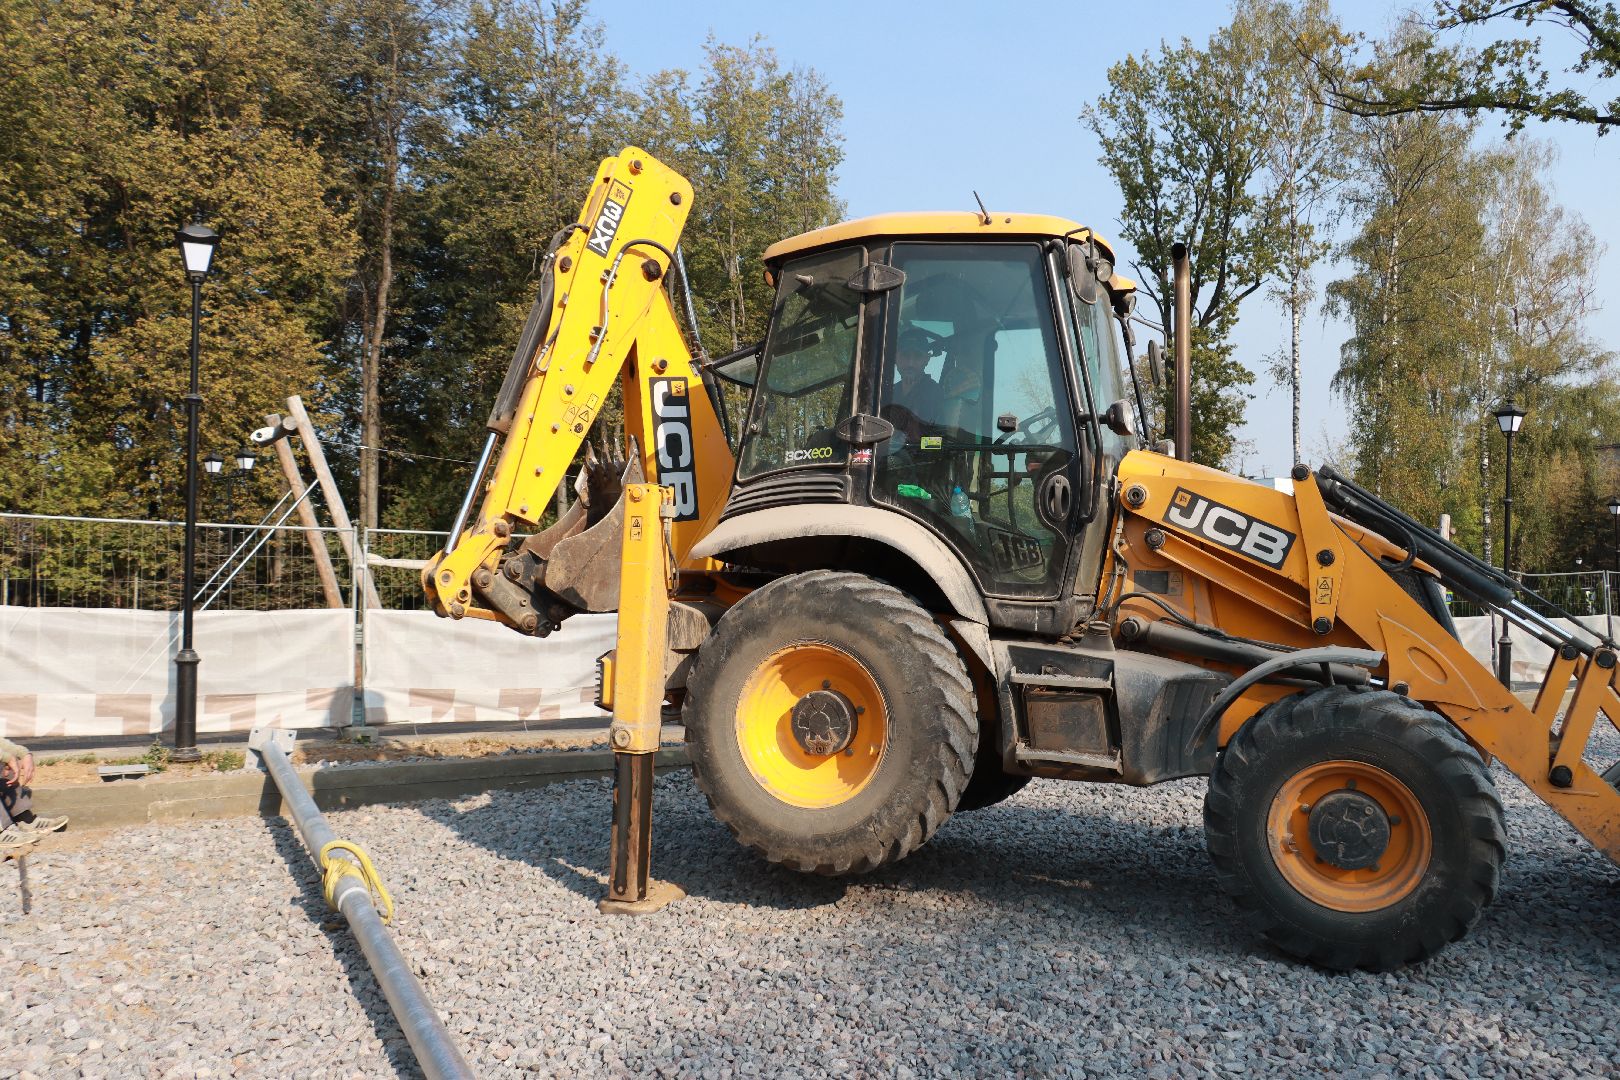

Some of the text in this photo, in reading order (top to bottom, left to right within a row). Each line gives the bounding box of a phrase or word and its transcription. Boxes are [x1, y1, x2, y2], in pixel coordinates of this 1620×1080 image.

[589, 200, 622, 252] 3CX
[653, 380, 696, 518] JCB
[1168, 498, 1289, 564] JCB
